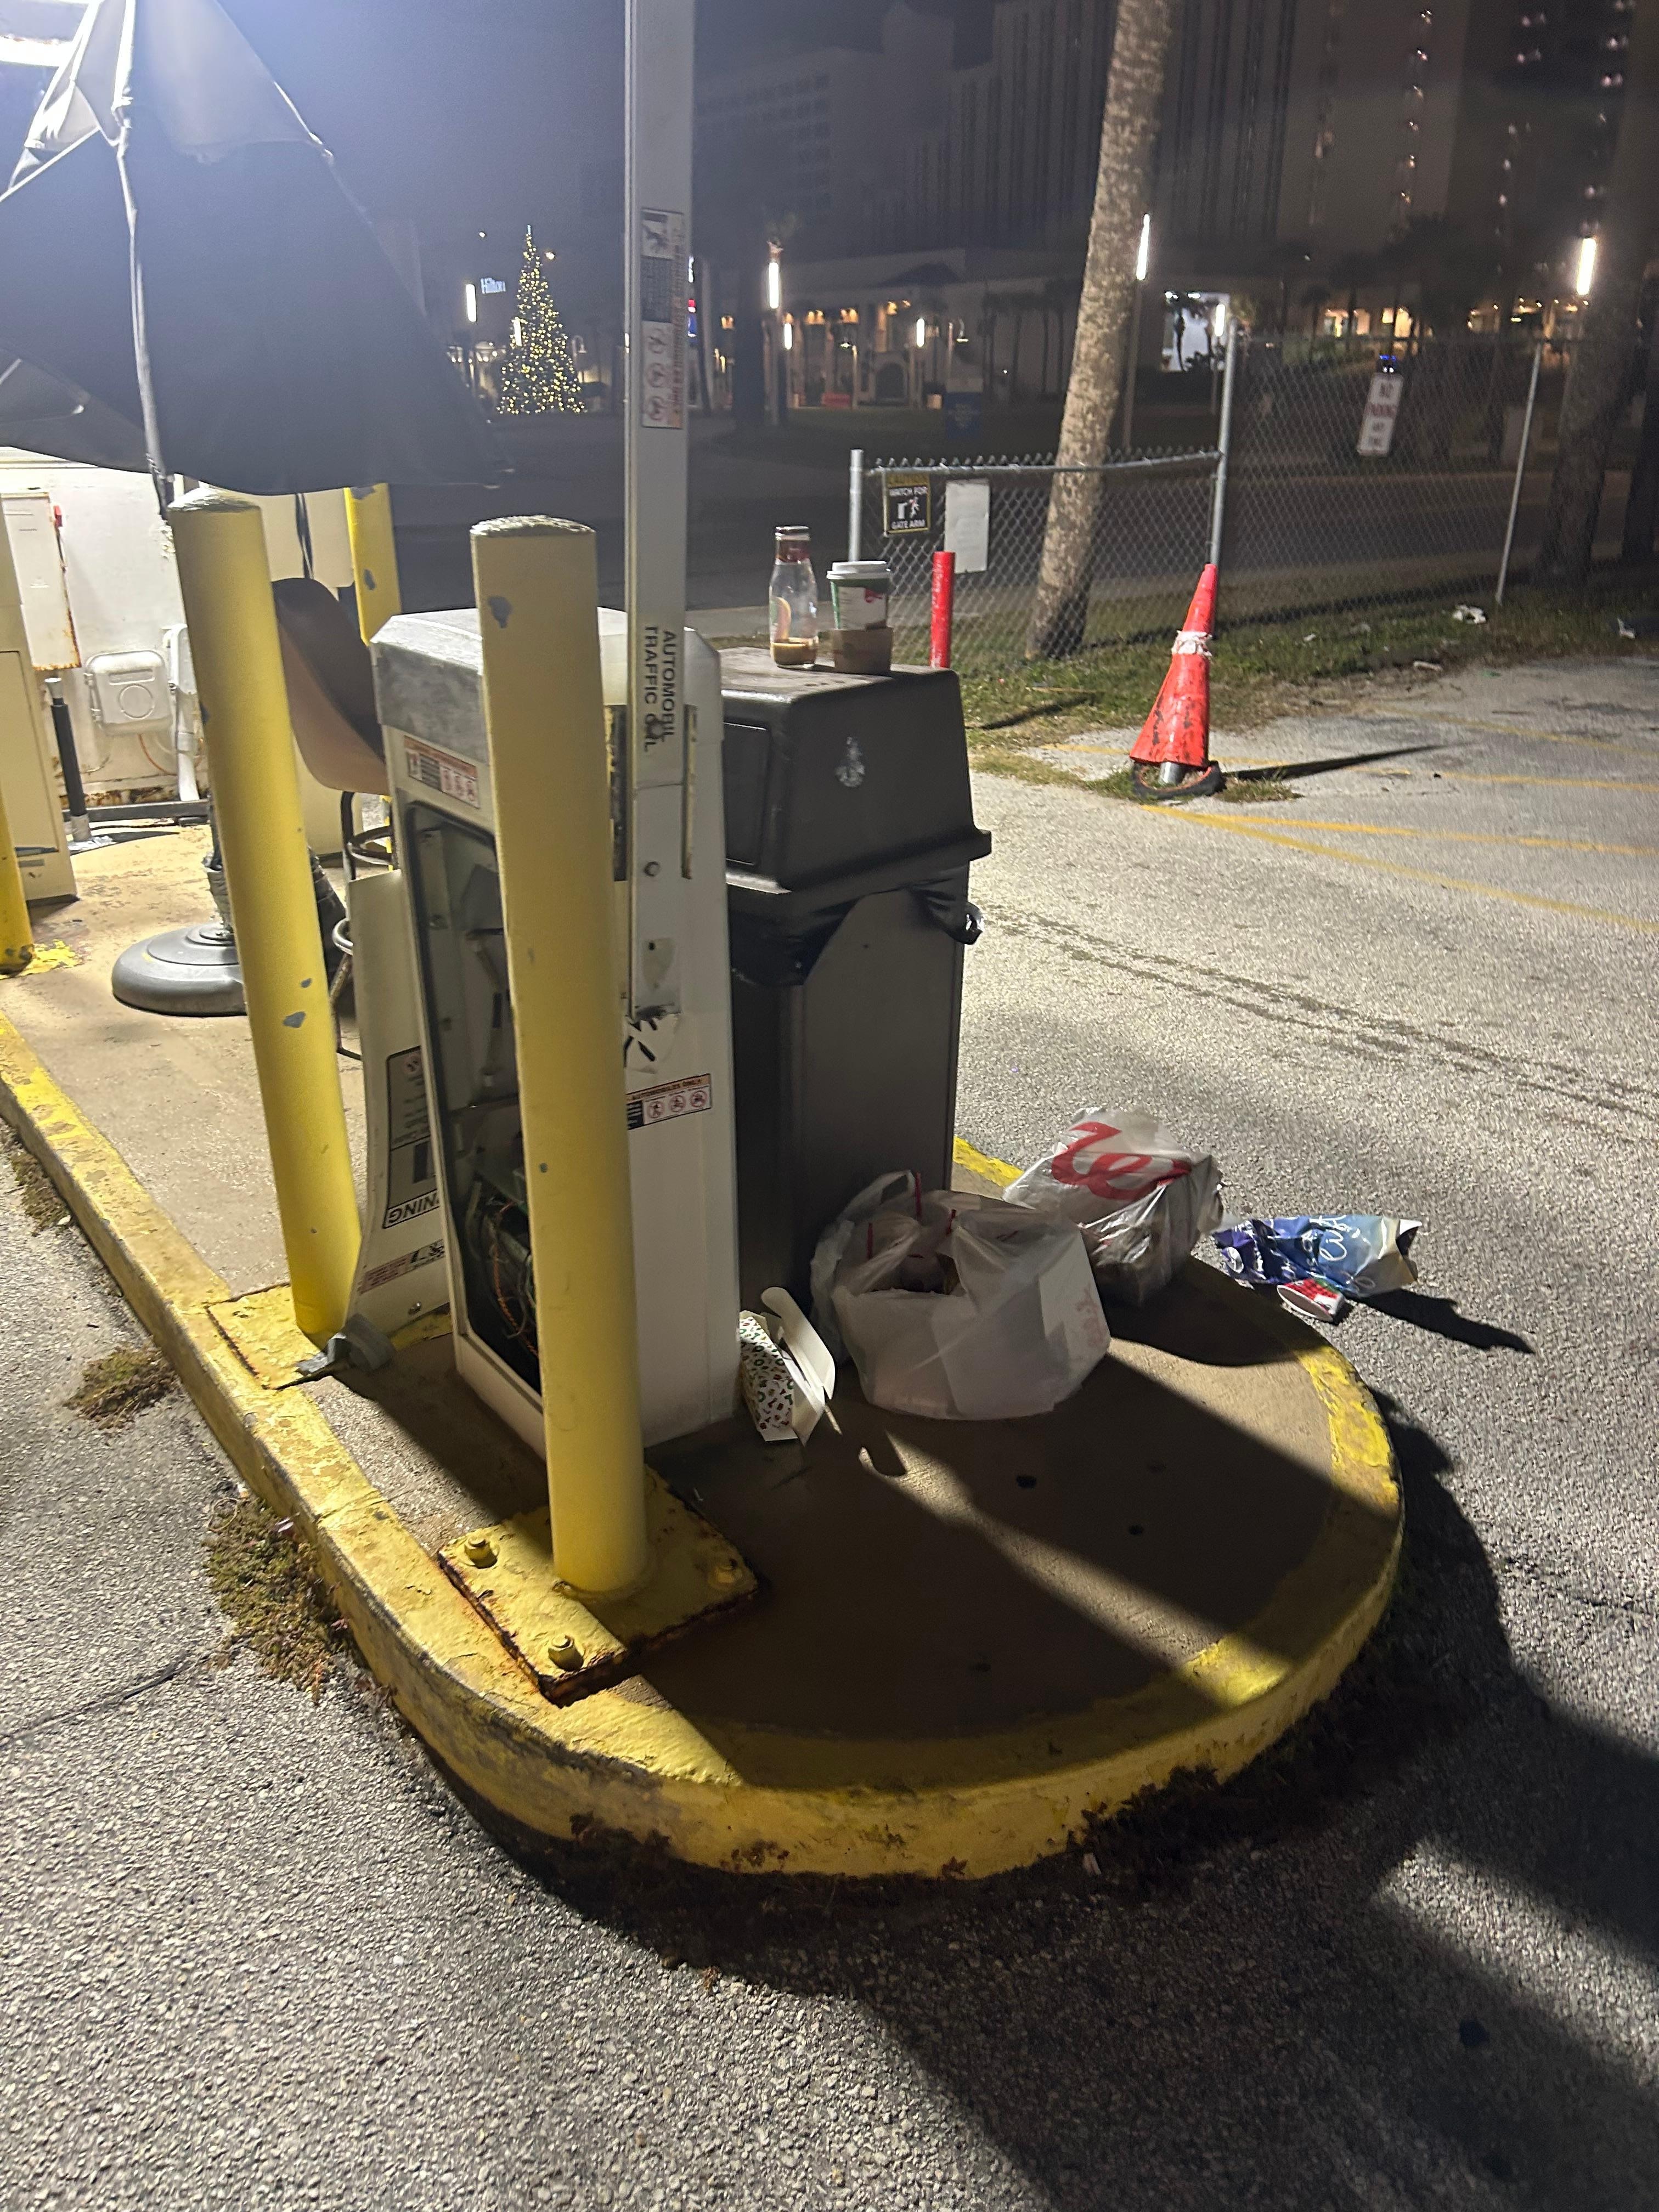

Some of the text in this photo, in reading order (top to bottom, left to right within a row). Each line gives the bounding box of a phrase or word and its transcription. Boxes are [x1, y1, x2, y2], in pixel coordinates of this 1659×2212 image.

[891, 519, 926, 530] GATE ARM
[645, 626, 658, 704] TRAFFIC
[388, 1193, 439, 1223] NING
